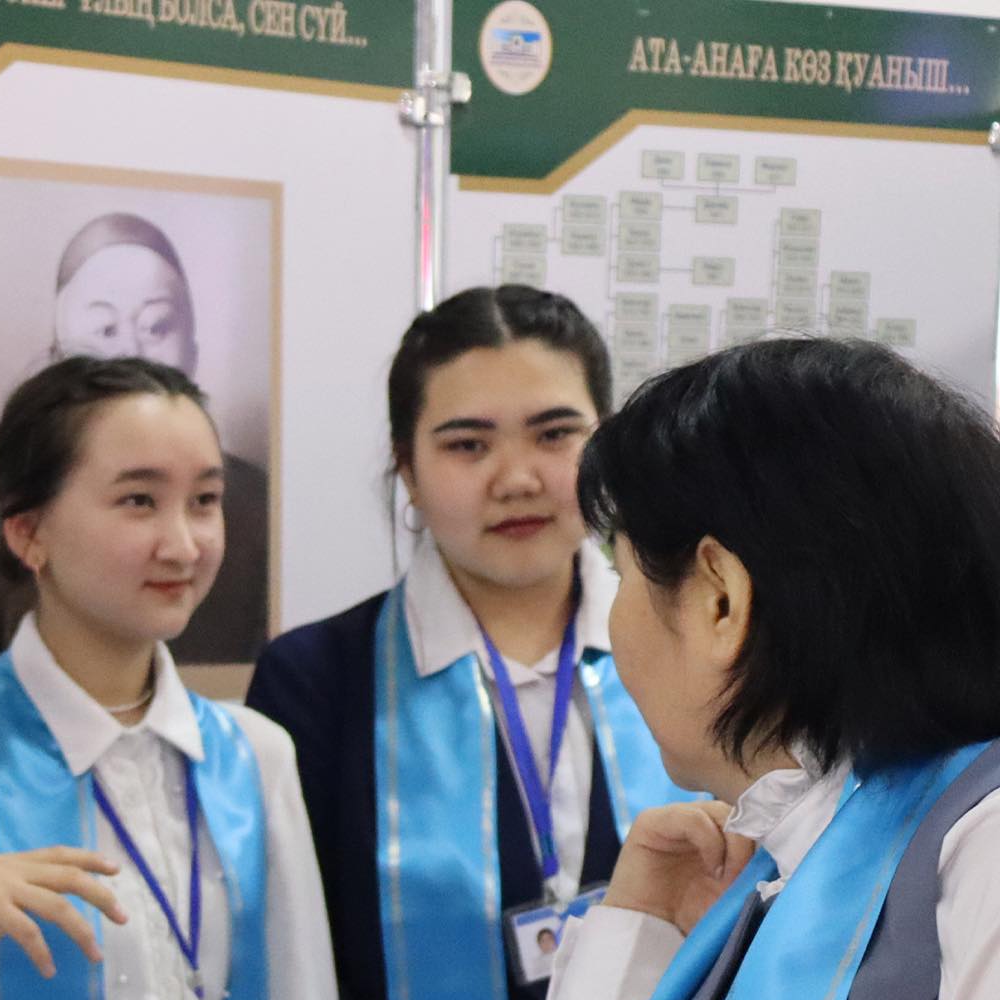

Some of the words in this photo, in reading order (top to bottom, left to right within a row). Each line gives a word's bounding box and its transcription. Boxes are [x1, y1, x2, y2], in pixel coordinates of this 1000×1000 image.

[249, 2, 296, 37] СЕН
[628, 36, 779, 82] АТА-АНАҒА
[783, 46, 832, 85] КӨЗ
